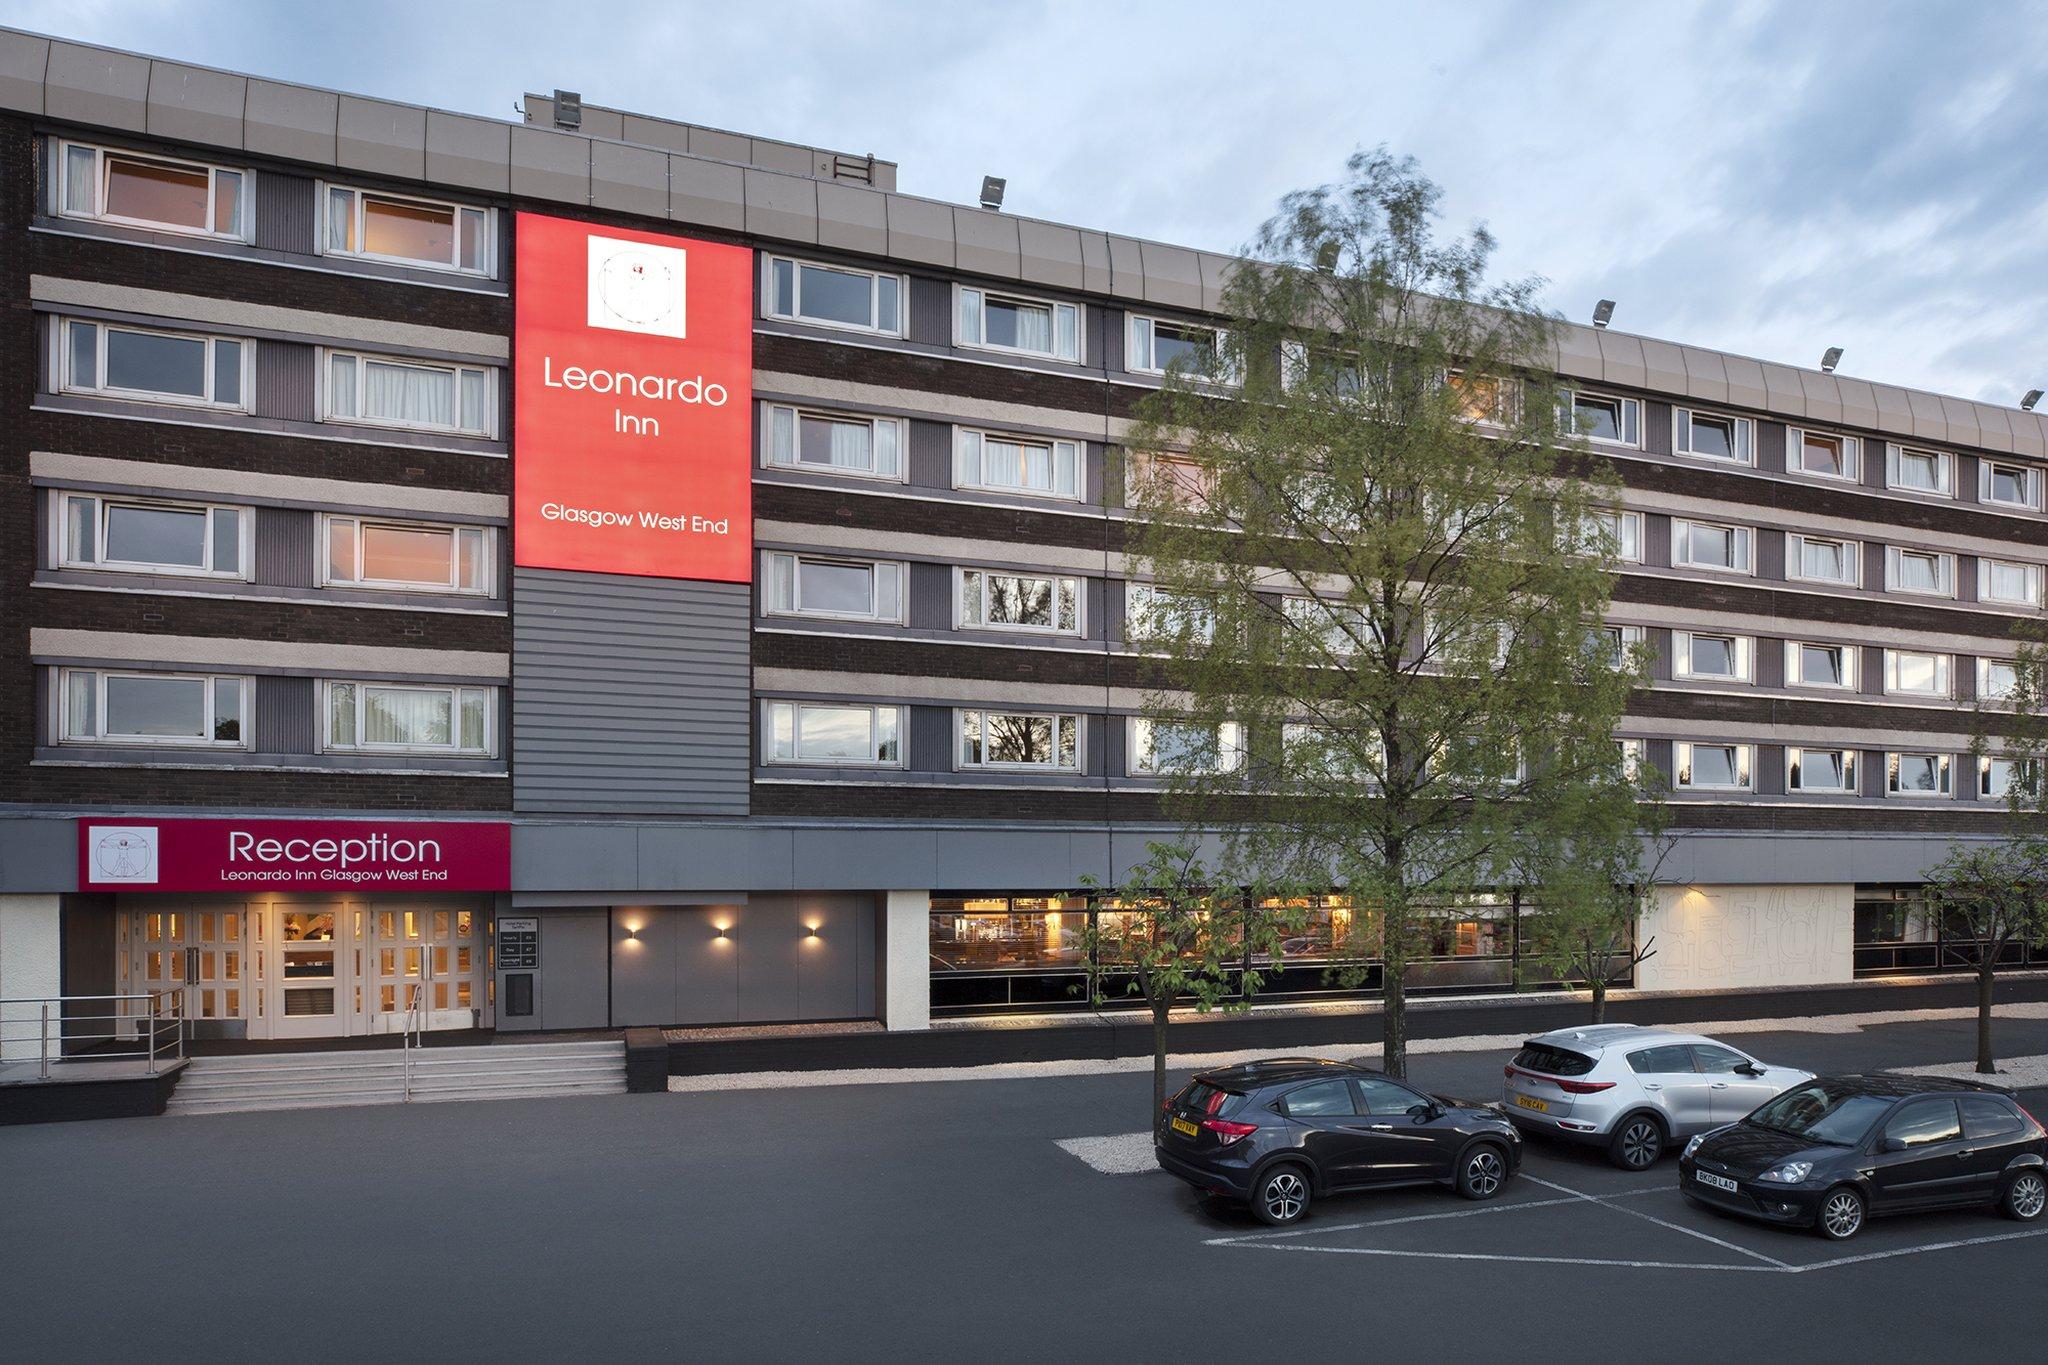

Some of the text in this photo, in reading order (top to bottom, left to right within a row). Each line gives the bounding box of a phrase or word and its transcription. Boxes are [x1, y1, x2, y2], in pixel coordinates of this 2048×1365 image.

[544, 356, 728, 407] Leonardo
[615, 408, 660, 437] Inn
[540, 502, 728, 535] Glasgow West End
[229, 831, 441, 869] Reception
[221, 869, 448, 883] Leonardo Inn Glasgow West End
